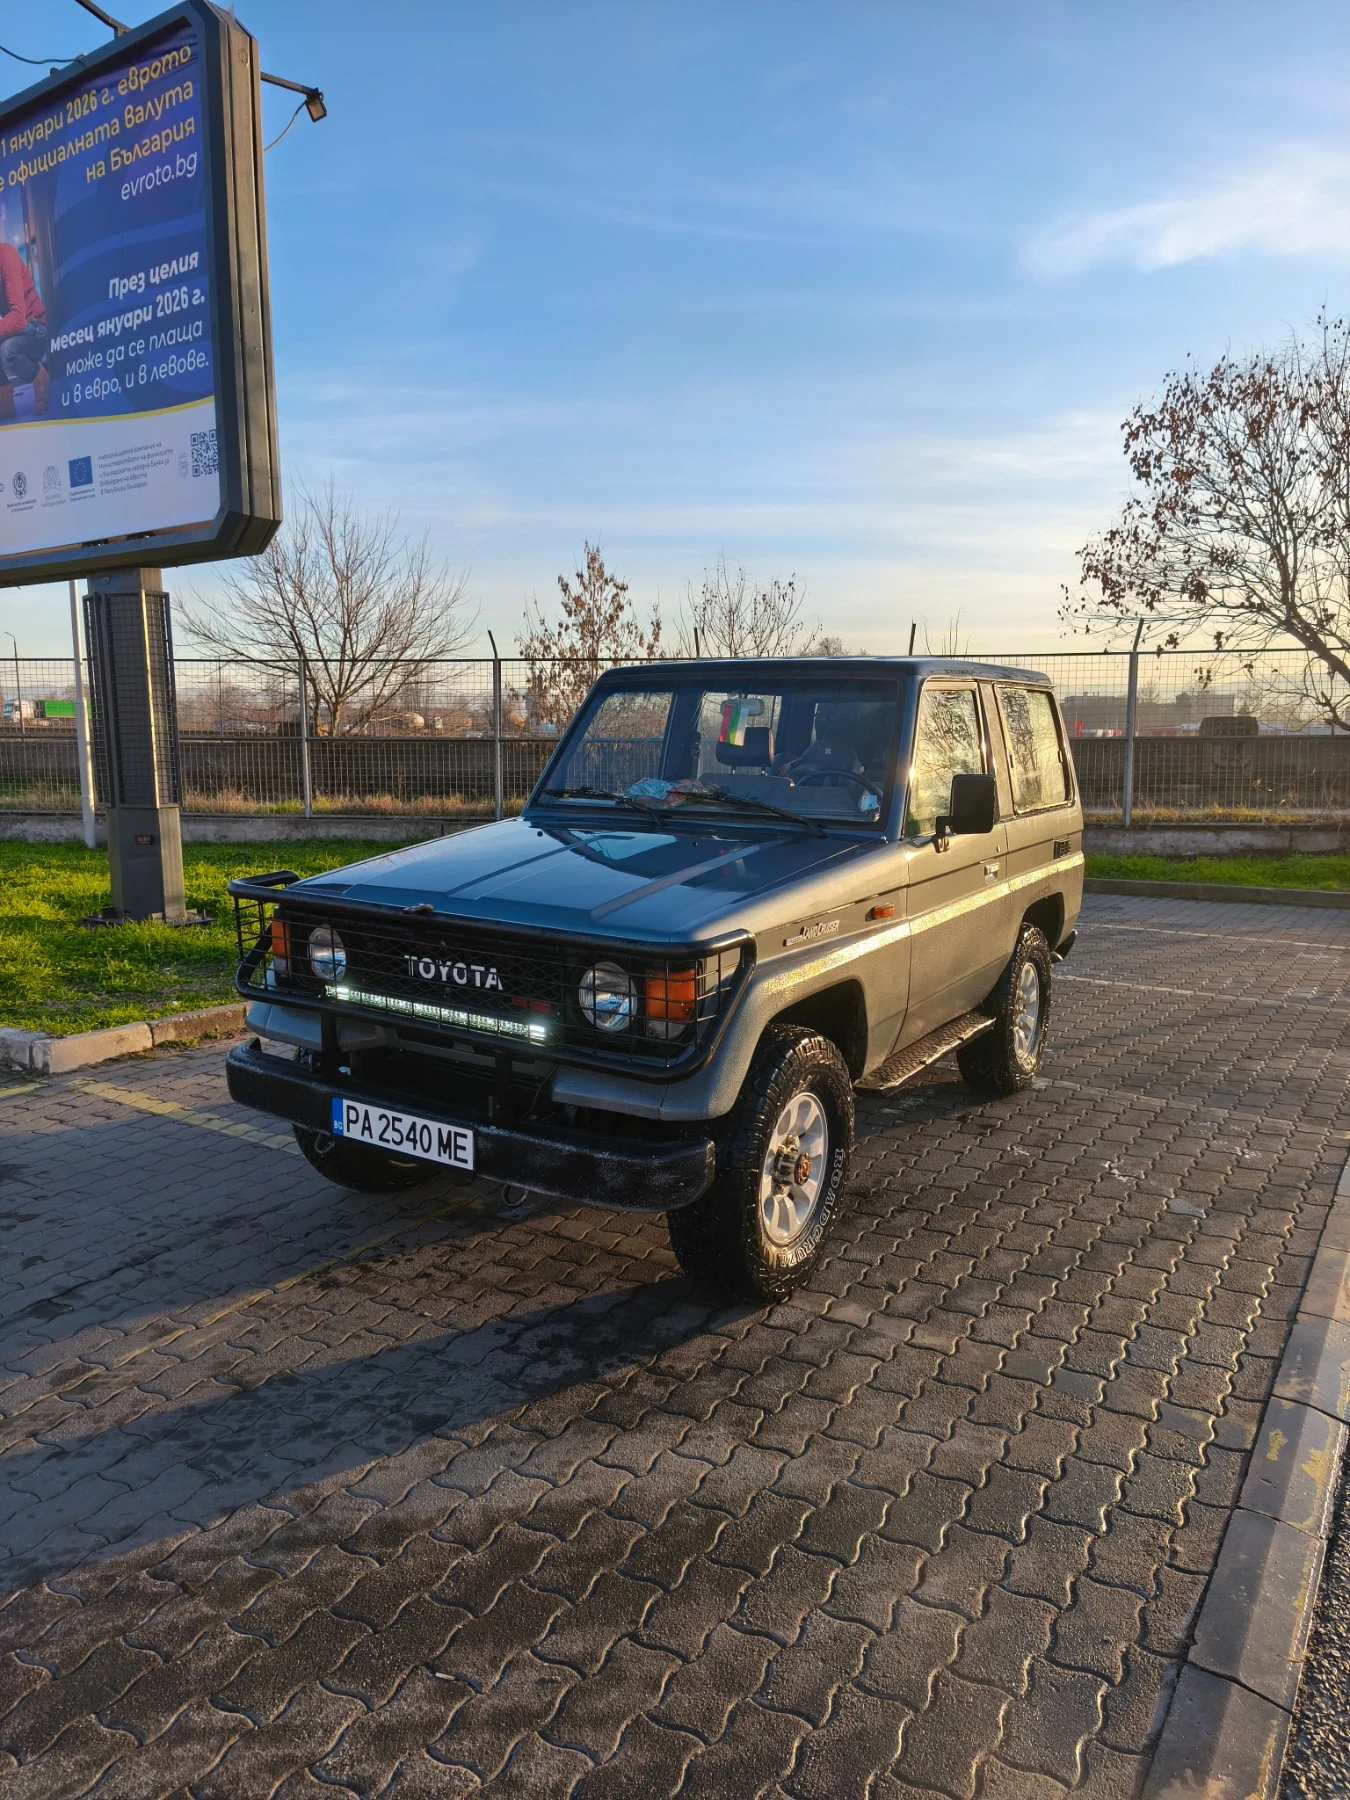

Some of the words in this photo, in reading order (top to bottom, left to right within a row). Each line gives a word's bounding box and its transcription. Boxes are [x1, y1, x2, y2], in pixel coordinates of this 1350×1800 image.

[1, 138, 6, 157] 1
[10, 112, 63, 154] януари
[66, 89, 97, 124] 2026
[101, 87, 114, 105] г.
[118, 45, 191, 95] еврото
[8, 118, 120, 186] официалната
[124, 81, 193, 129] валута
[86, 160, 105, 183] на
[110, 117, 195, 172] България
[121, 152, 198, 201] evroto.bg
[109, 272, 146, 300] През
[150, 251, 199, 285] целия
[51, 325, 94, 353] месец
[97, 305, 153, 337] януари
[156, 286, 189, 318] 2026
[192, 288, 205, 305] г.
[66, 350, 103, 377] може
[106, 345, 125, 369] да
[129, 339, 146, 357] се
[149, 320, 203, 352] плаща
[61, 391, 70, 407] и
[73, 383, 82, 403] в
[84, 377, 122, 401] евро,
[125, 372, 134, 388] и
[138, 364, 147, 385] в
[150, 349, 209, 382] левове.
[404, 954, 504, 991] TOYOTA
[333, 1120, 343, 1131] BG
[346, 1104, 374, 1140] PA
[378, 1113, 433, 1154] 2540
[437, 1127, 469, 1165] ME
